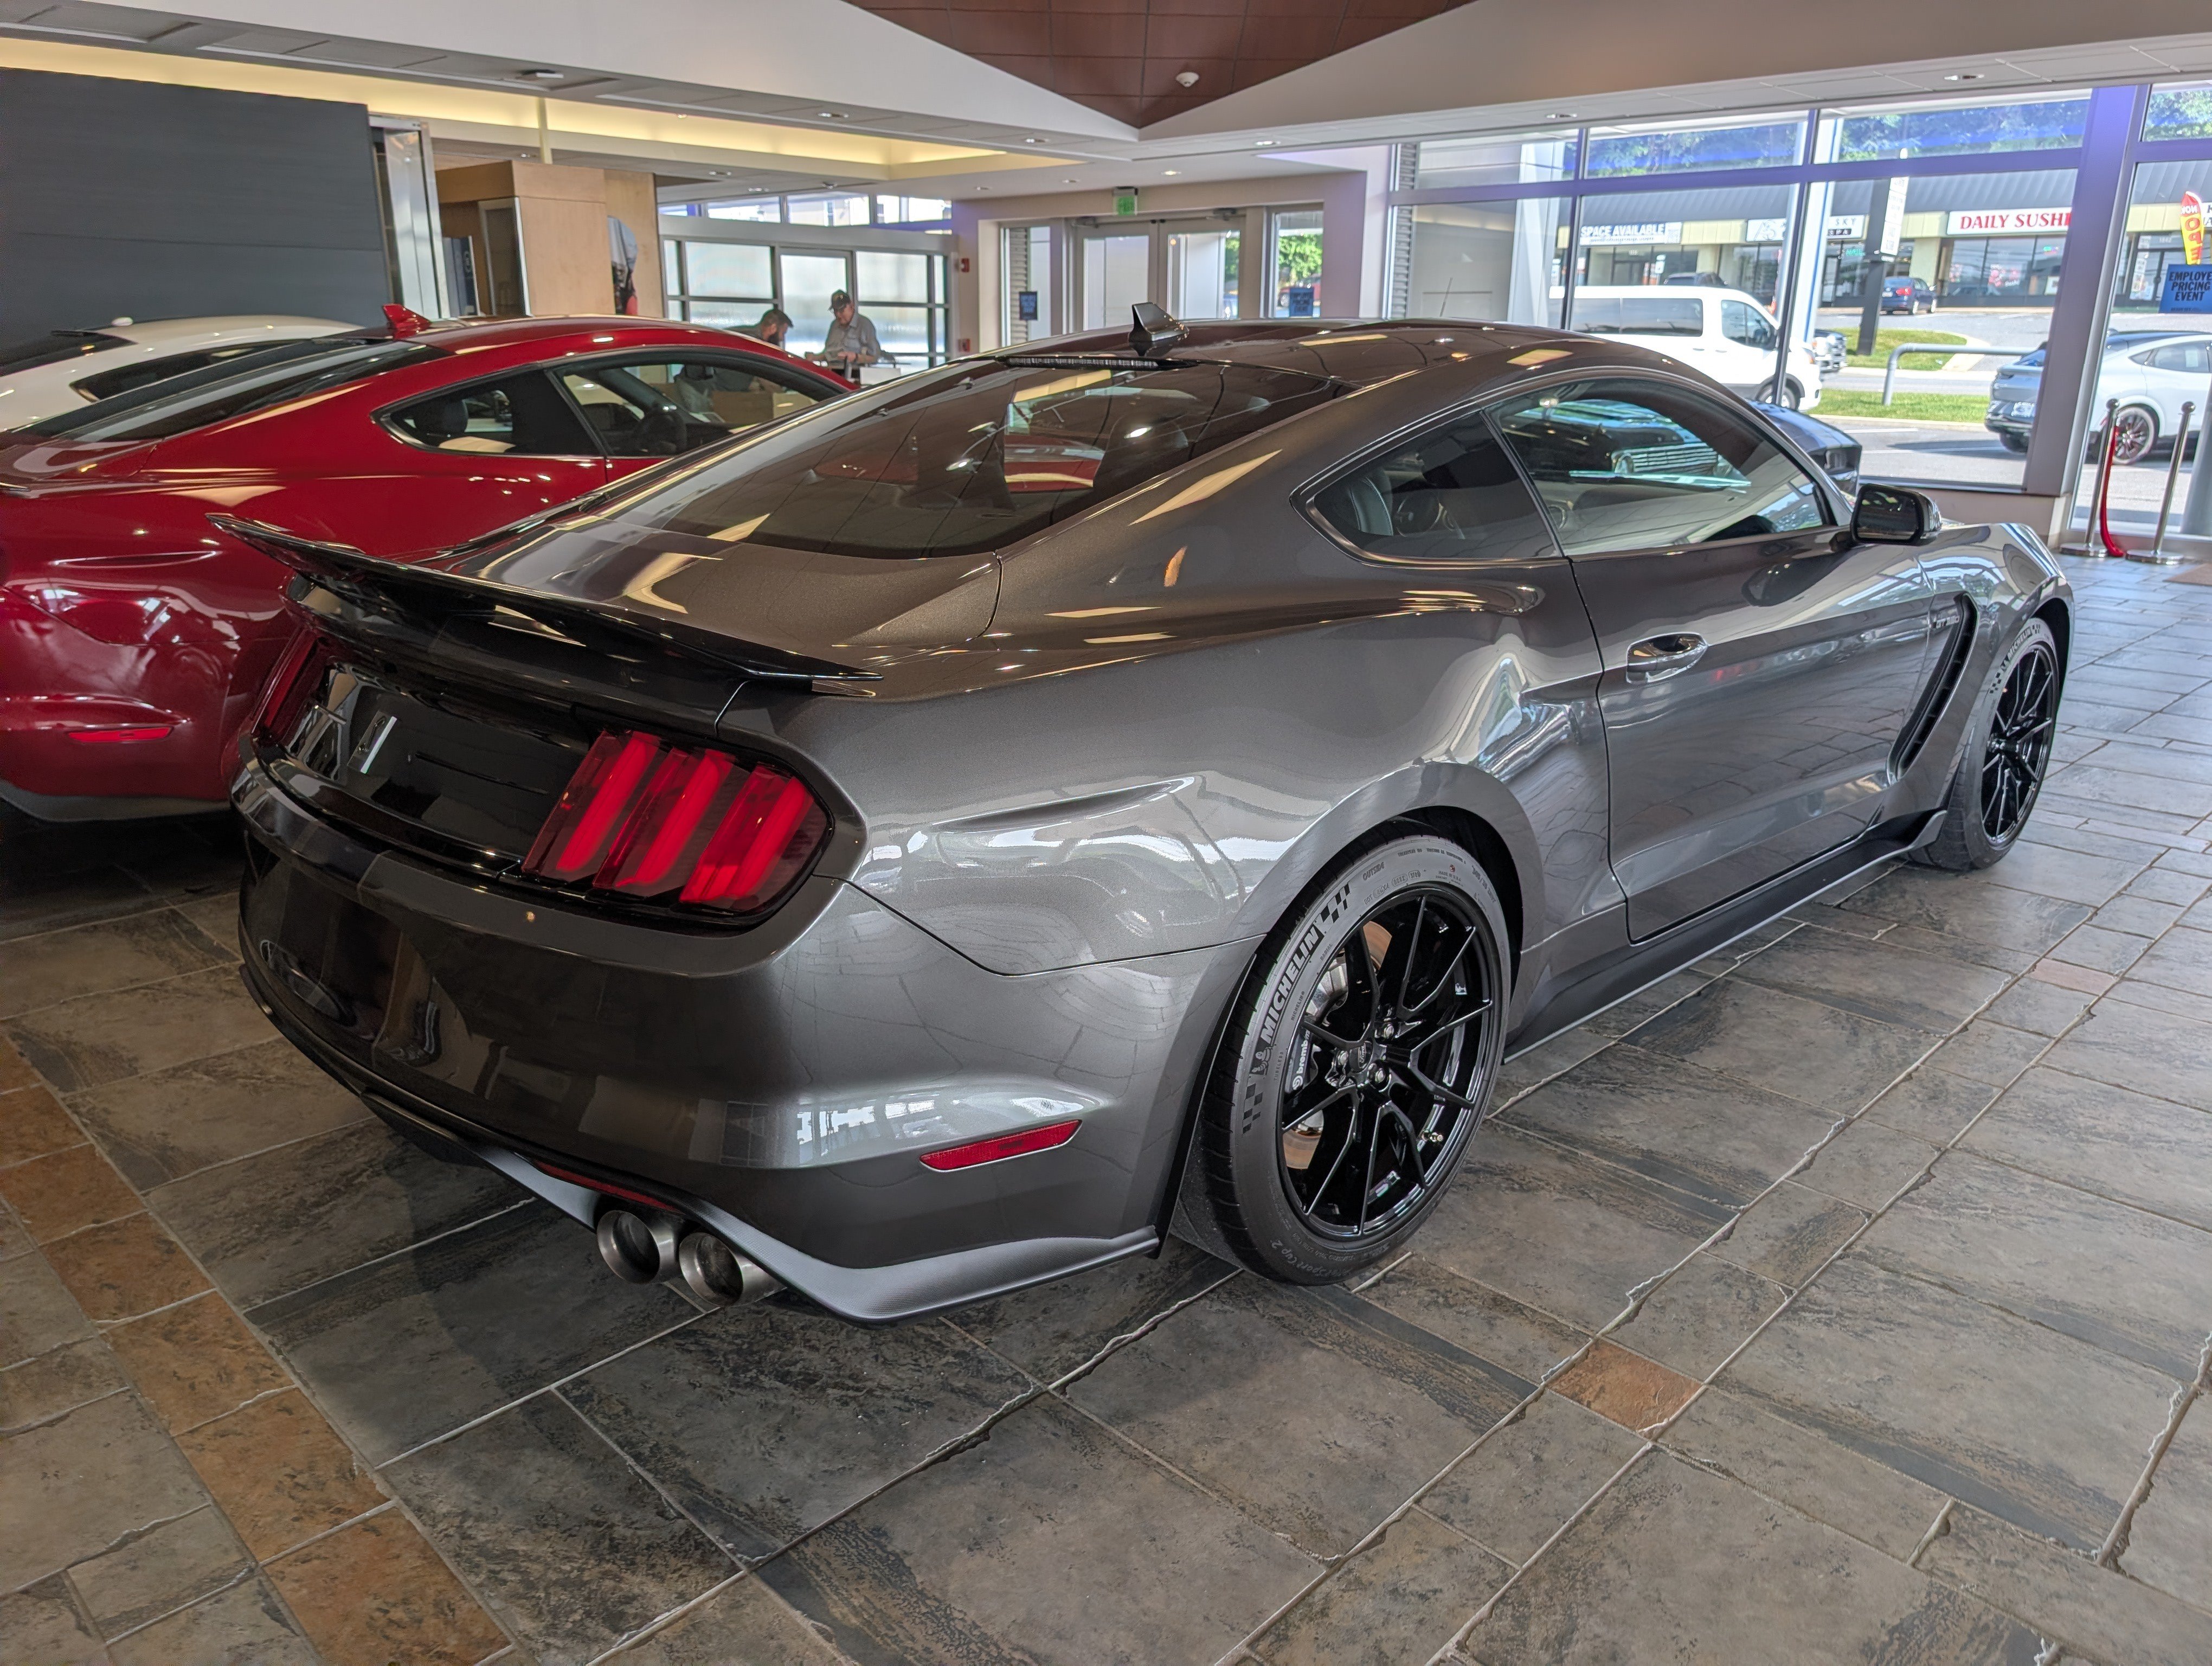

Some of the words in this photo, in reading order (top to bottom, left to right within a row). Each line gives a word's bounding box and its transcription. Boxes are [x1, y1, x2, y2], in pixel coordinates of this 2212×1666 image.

[1836, 217, 1856, 226] SKY
[1960, 214, 2009, 229] DAILY
[2014, 212, 2072, 228] SUSHI
[1581, 225, 1612, 237] SPACE
[1612, 223, 1664, 236] AVAILABLE
[2171, 282, 2210, 291] PRICING
[2175, 292, 2204, 301] EVENT
[1261, 926, 1319, 1044] MICHELIN
